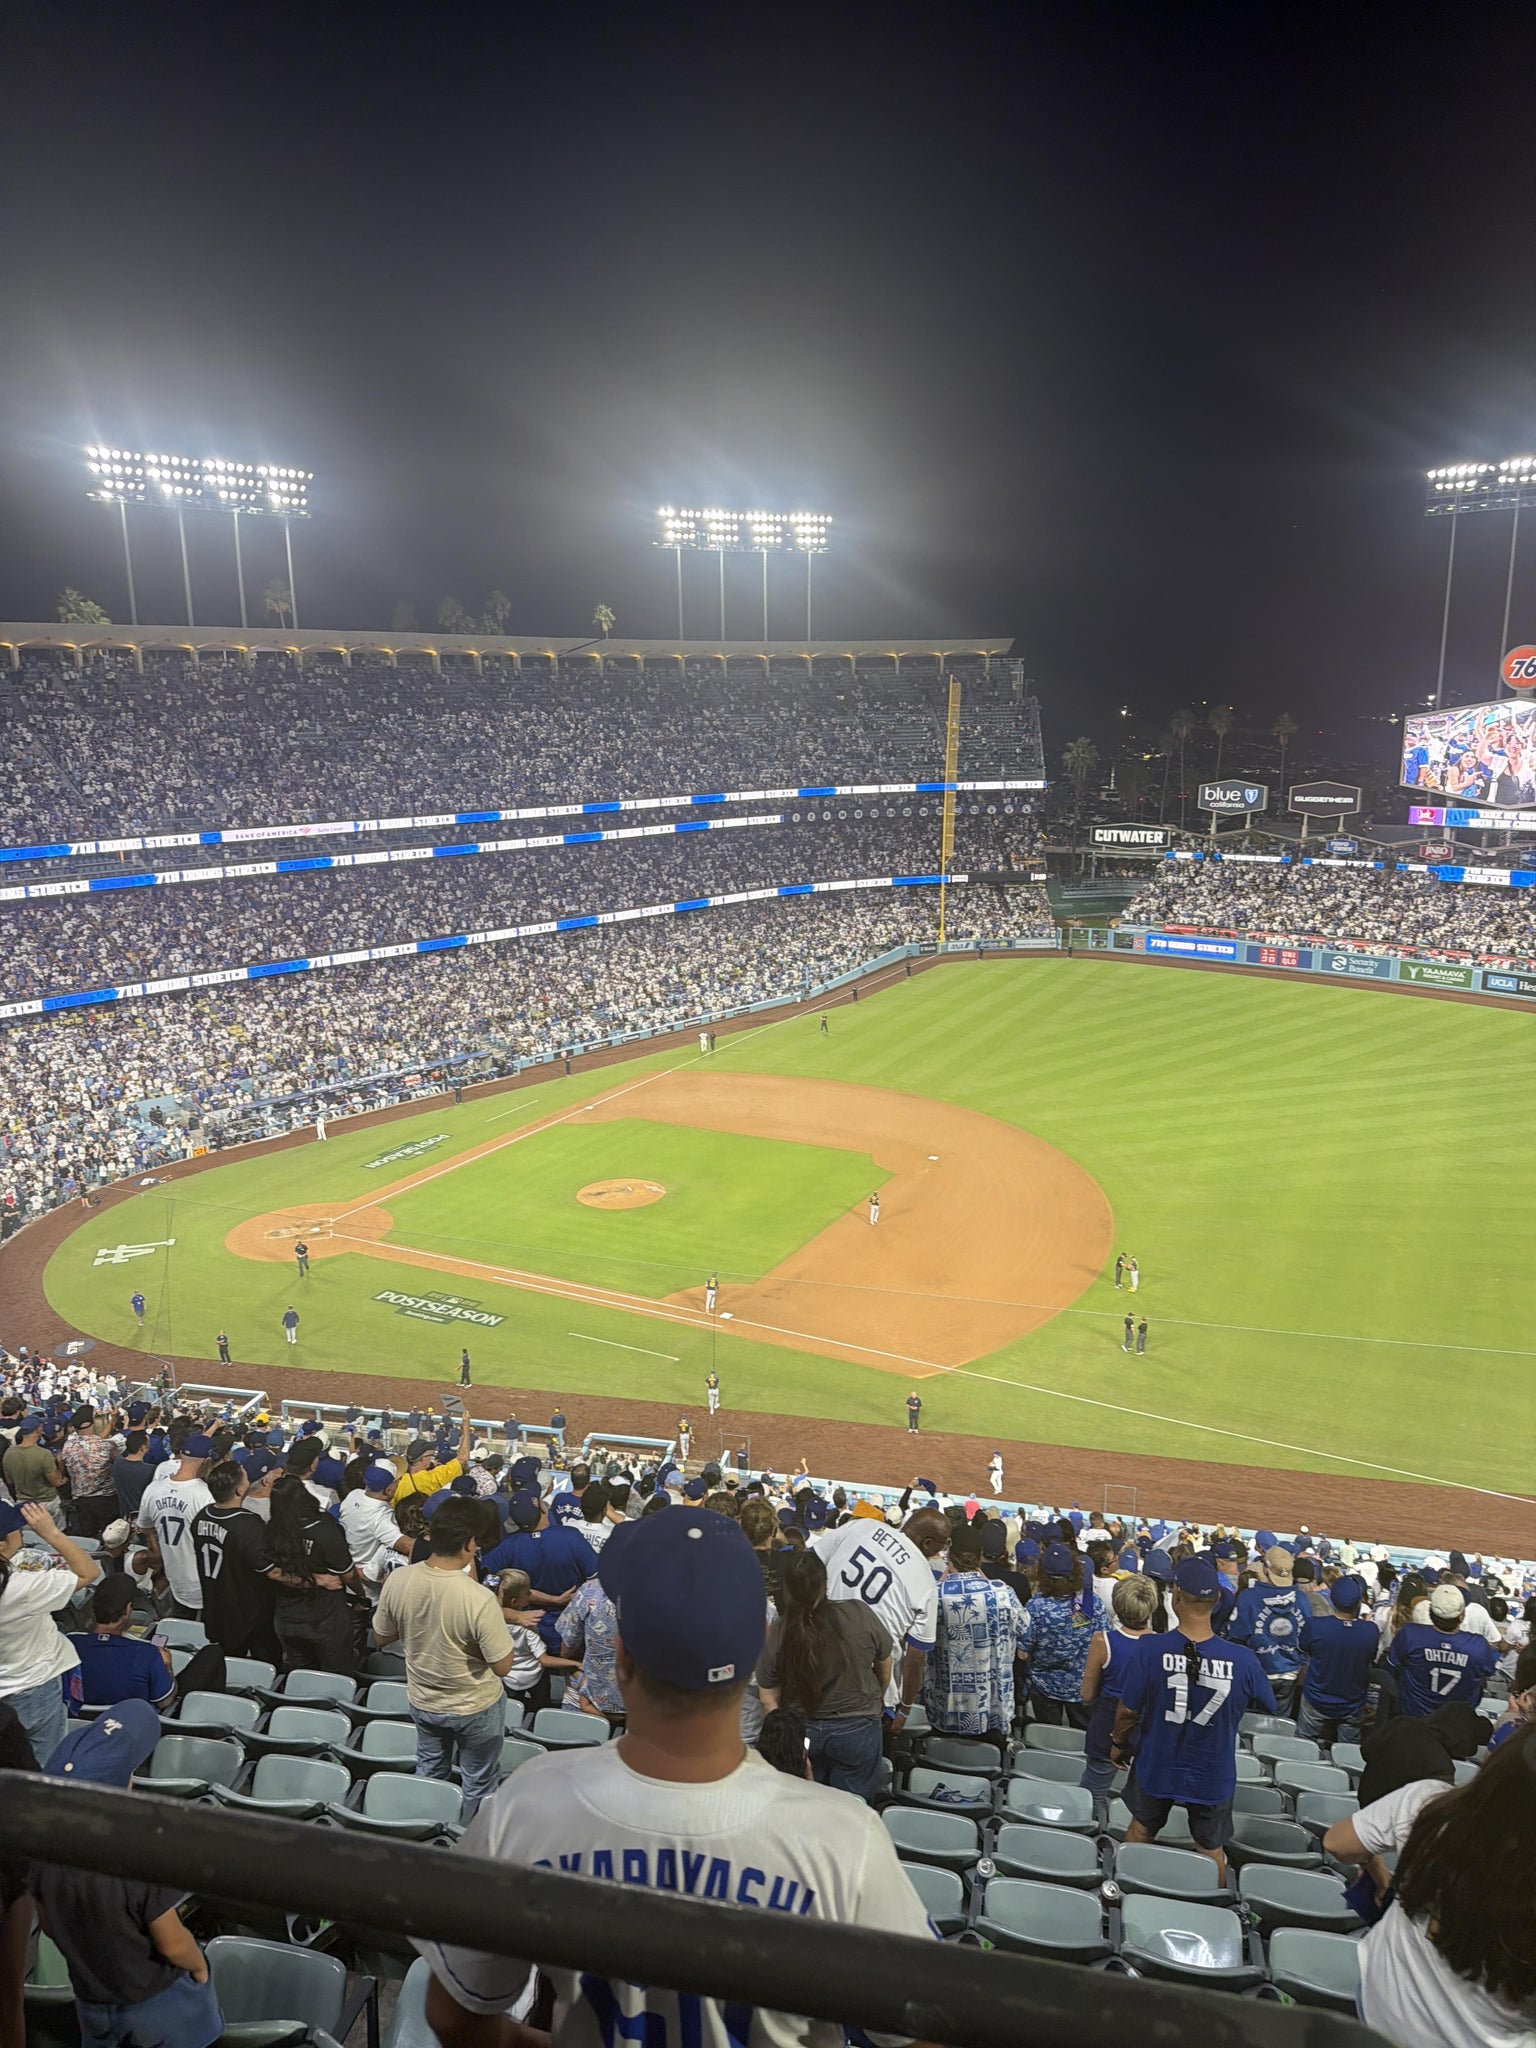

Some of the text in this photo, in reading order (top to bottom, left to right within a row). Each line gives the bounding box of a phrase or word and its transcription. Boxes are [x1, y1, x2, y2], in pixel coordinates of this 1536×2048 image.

[1509, 656, 1536, 678] 76
[1205, 787, 1241, 801] blue
[1294, 796, 1344, 804] GUGGENHEIM
[1209, 801, 1245, 809] california
[70, 833, 200, 855] 7TH INNING STRETCH
[235, 832, 254, 840] BANK
[267, 829, 298, 837] AMERICA
[1095, 829, 1164, 844] CUTWATER
[1425, 846, 1449, 855] JINRO
[156, 871, 180, 884] 7TH
[225, 862, 276, 877] STRETCH
[28, 880, 89, 897] STRETCH
[1151, 938, 1167, 948] 7TH
[1196, 943, 1235, 954] STRETCH
[1282, 957, 1296, 965] QLO
[1349, 965, 1375, 975] Benefit
[1350, 957, 1379, 969] Security
[117, 983, 143, 998] 7TH
[192, 968, 247, 987] STRETCH
[1491, 978, 1514, 988] UCLA
[363, 1134, 451, 1168] POSTSEASON
[374, 1291, 504, 1326] POSTSEASON
[155, 1496, 188, 1513] OHTANI
[160, 1515, 185, 1546] 17
[197, 1519, 228, 1544] OHTANI
[872, 1528, 911, 1565] BETTS
[201, 1542, 223, 1579] 17
[841, 1545, 893, 1605] 50
[1163, 1653, 1234, 1680] OHANI
[1424, 1647, 1469, 1667] OHTANI
[1429, 1667, 1462, 1696] 17
[1165, 1672, 1232, 1727] 17
